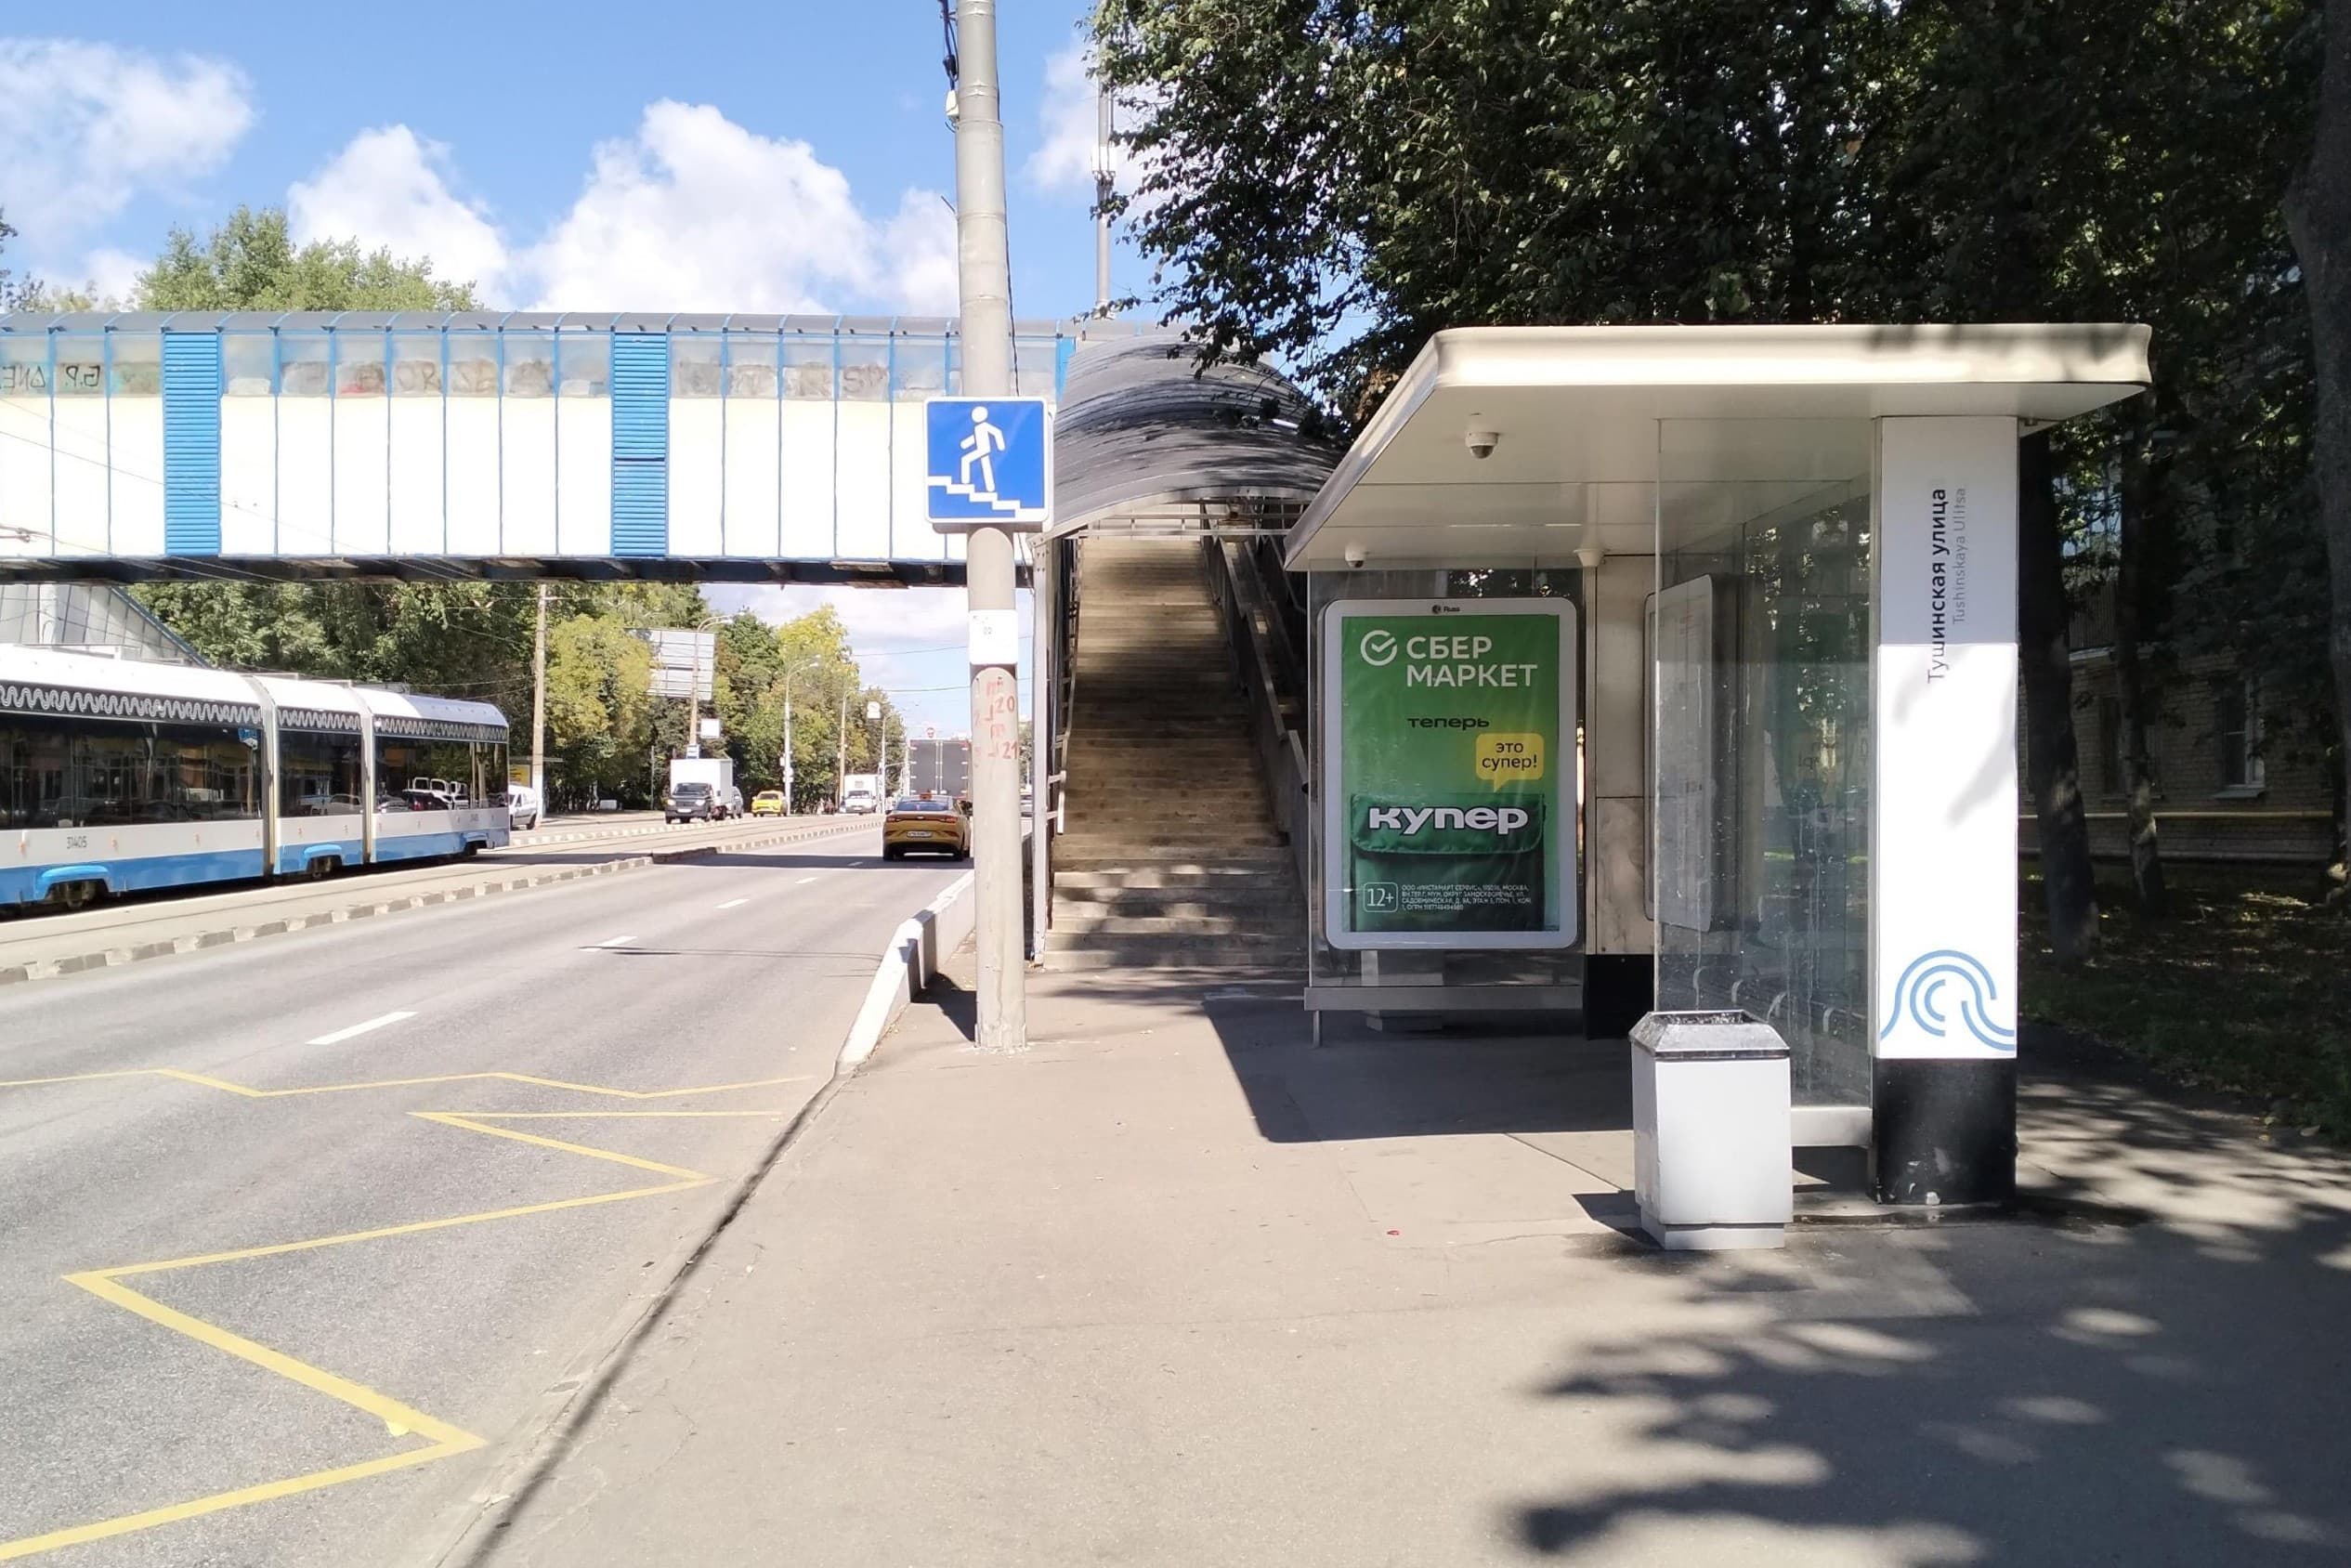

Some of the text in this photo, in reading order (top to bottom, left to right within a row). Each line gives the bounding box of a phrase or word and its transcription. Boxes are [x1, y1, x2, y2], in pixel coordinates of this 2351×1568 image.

[1953, 488, 1969, 625] Tushinskaya Ulitsa
[1927, 489, 1951, 684] Тушинская улица
[1406, 635, 1493, 660] СБЕР
[1406, 663, 1538, 687] МАРКЕТ
[1407, 716, 1490, 731] теперь
[1495, 742, 1524, 754] это
[1482, 753, 1538, 772] супер!
[1368, 805, 1529, 836] купер
[1366, 887, 1394, 907] 12+
